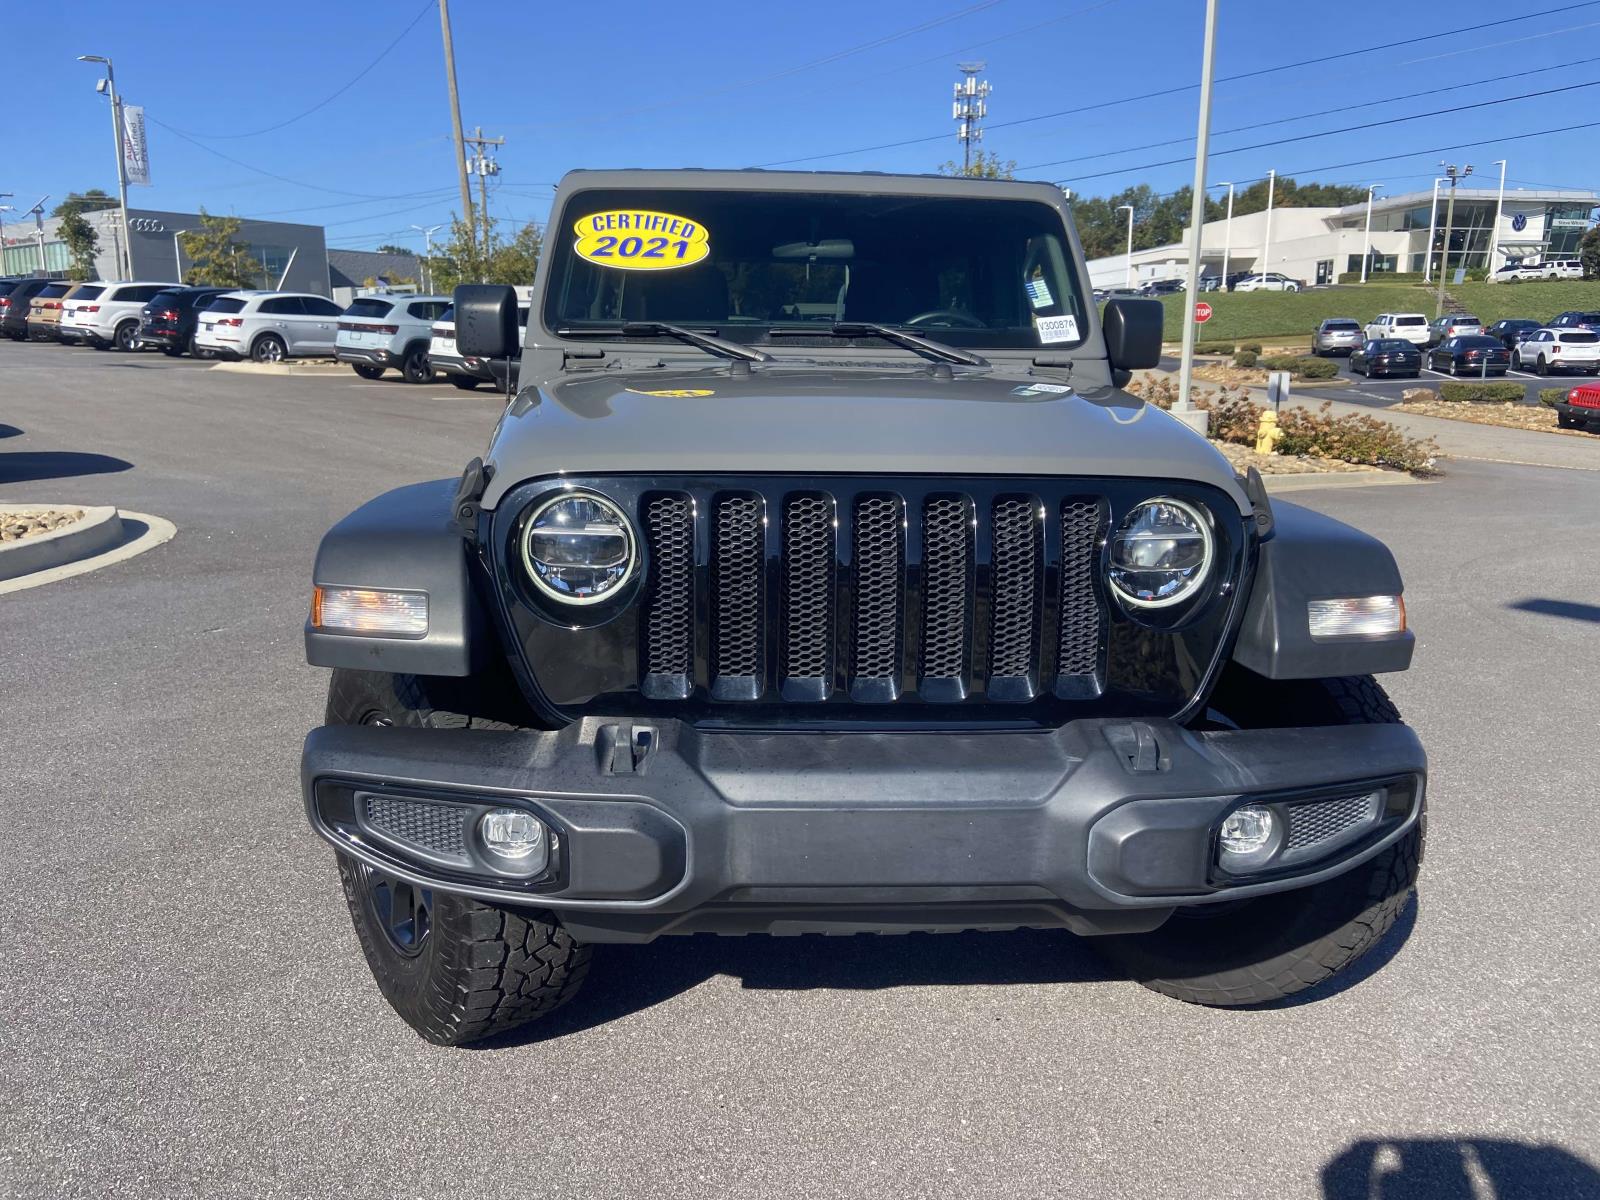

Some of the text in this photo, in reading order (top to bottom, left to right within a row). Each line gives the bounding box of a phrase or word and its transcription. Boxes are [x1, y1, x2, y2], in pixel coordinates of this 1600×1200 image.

[592, 213, 696, 239] CERTIFIED
[590, 236, 689, 259] 2021
[1197, 308, 1210, 317] TOP
[1039, 319, 1075, 331] V30087A
